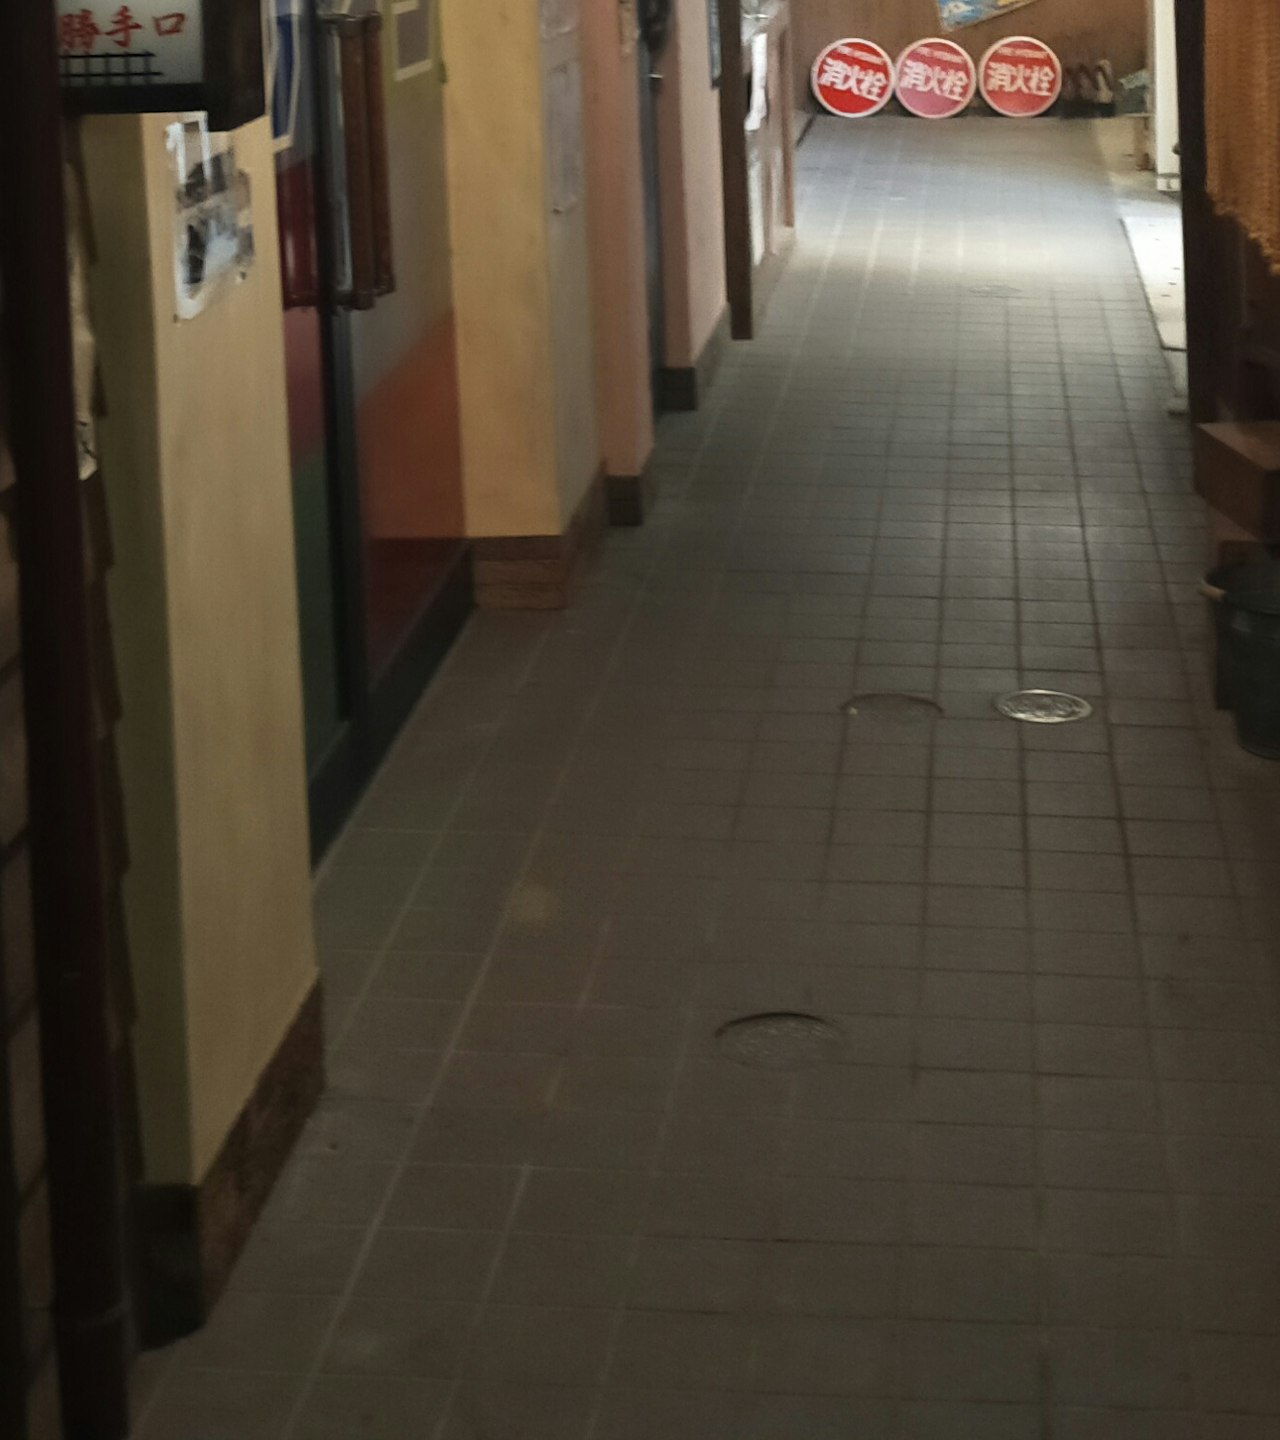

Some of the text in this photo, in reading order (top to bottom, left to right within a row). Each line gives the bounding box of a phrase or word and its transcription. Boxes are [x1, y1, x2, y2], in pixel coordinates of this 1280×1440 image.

[59, 5, 187, 51] 勝手口
[820, 57, 887, 101] 消火栓
[899, 59, 969, 102] 消火栓
[986, 61, 1055, 97] 消火栓
